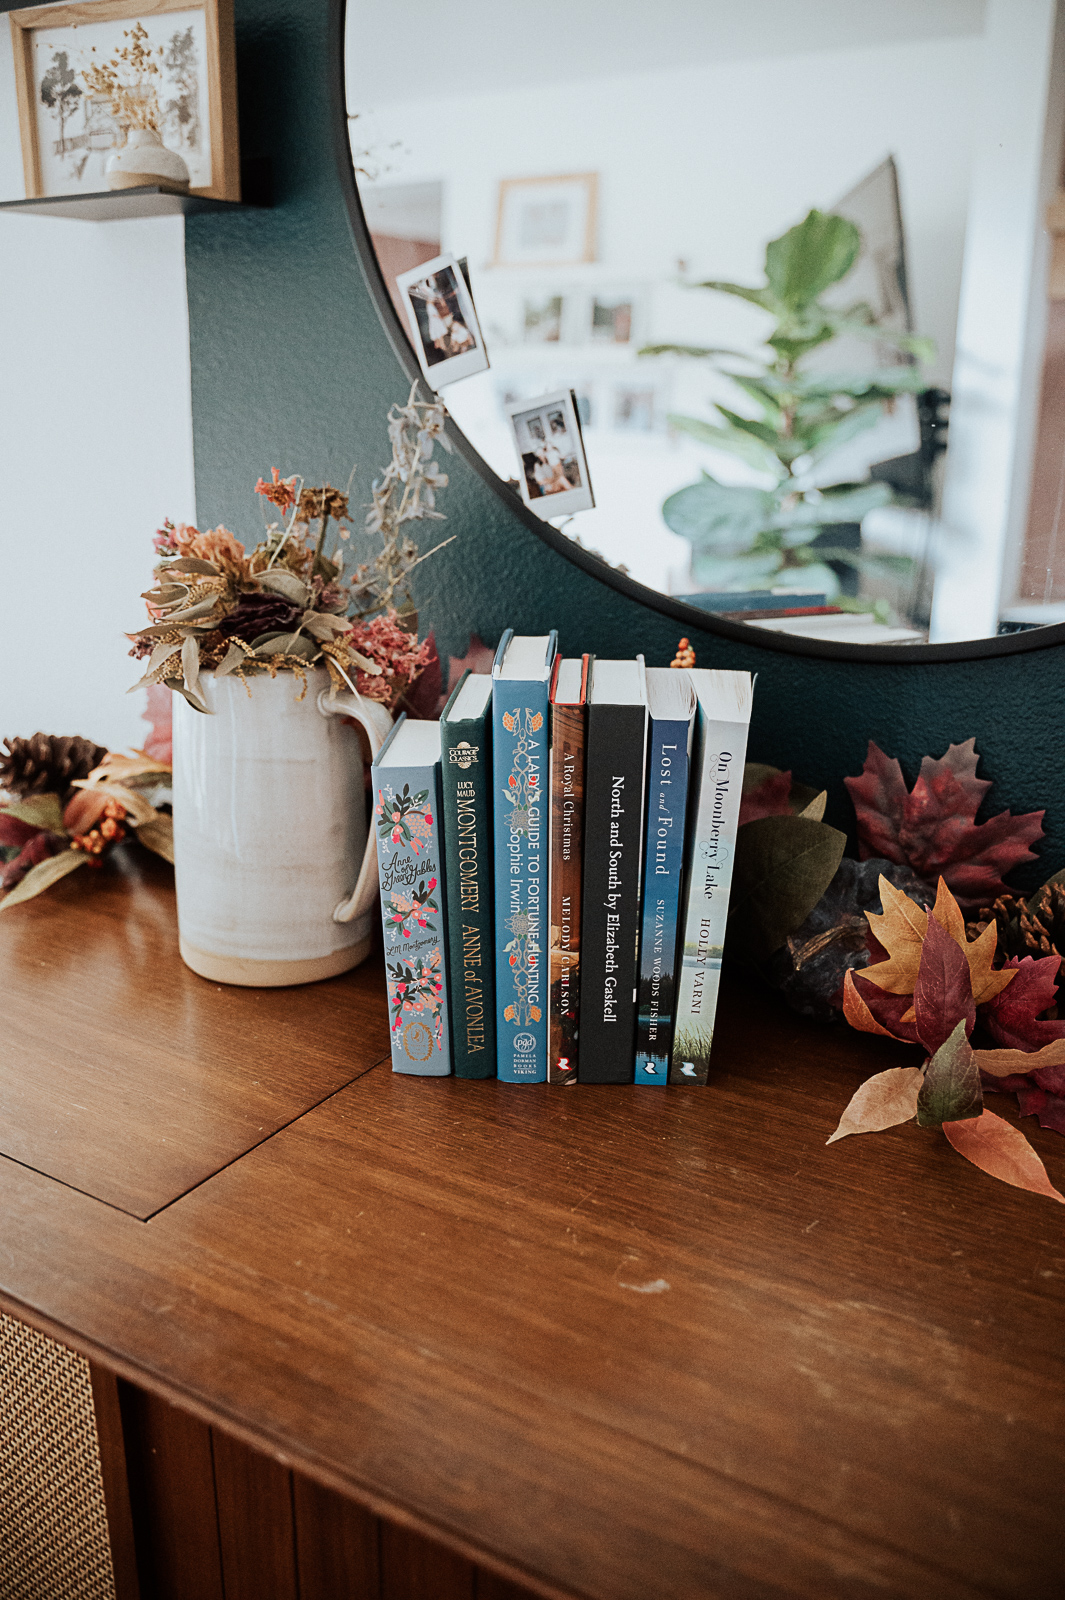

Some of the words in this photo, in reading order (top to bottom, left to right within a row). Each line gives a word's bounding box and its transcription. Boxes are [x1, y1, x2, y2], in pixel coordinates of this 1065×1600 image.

[528, 739, 540, 750] A
[564, 752, 575, 761] A
[660, 744, 677, 785] Lost
[717, 751, 732, 772] On
[456, 789, 476, 797] MAUD
[457, 781, 474, 789] LUCY
[528, 755, 540, 802] LADY'S
[561, 765, 575, 797] Royal
[610, 776, 625, 818] North
[658, 792, 670, 813] and
[705, 779, 730, 861] Moonberry
[527, 807, 540, 849] GUIDE
[562, 801, 575, 861] Christmas
[609, 822, 624, 847] and
[655, 817, 673, 875] Found
[381, 851, 412, 873] Anne
[400, 863, 410, 875] of
[457, 799, 480, 912] MONTGOMERY
[507, 827, 524, 875] Sophie
[527, 855, 540, 873] TO
[608, 850, 622, 890] South
[381, 870, 408, 892] Green
[401, 858, 437, 886] Gables
[704, 865, 720, 900] Lake
[510, 879, 524, 913] Irwin
[604, 894, 622, 910] by
[527, 877, 540, 1003] FORTUNE-HUNTING
[561, 896, 571, 950] MELODY
[654, 900, 665, 954] SUZANNE
[696, 918, 711, 966] HOLLY
[402, 935, 441, 952] Montgomery
[462, 924, 482, 968] ANNE
[605, 914, 621, 973] Elizabeth
[464, 970, 483, 983] of
[560, 956, 570, 1015] CARLSON
[651, 957, 662, 997] WOODS
[690, 971, 705, 1014] VARNI
[465, 985, 485, 1054] AVONLEA
[603, 977, 618, 1022] Gaskell
[648, 1001, 659, 1041] FISHER
